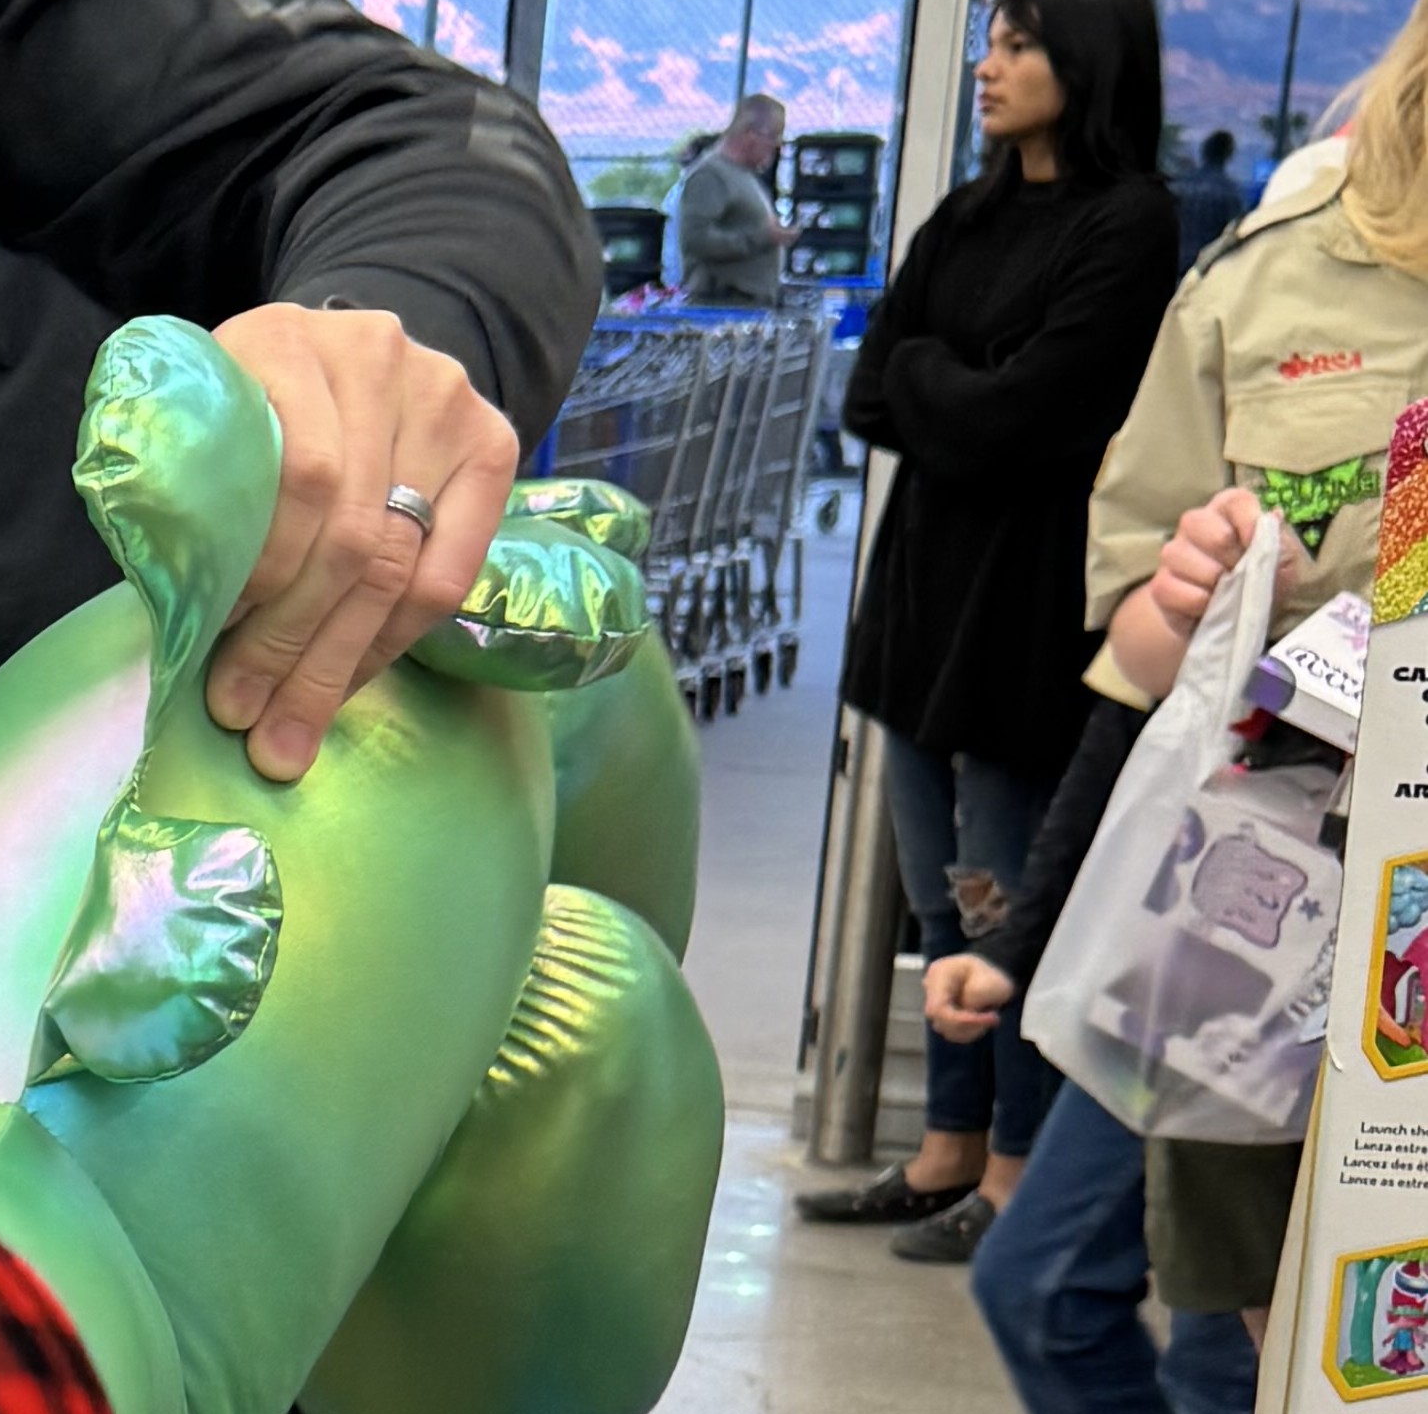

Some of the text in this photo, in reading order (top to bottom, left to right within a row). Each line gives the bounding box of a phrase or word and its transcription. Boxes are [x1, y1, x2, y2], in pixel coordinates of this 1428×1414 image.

[1361, 1121, 1407, 1135] Launch
[1354, 1138, 1392, 1152] Lanza
[1391, 1159, 1413, 1171] des
[1340, 1171, 1377, 1186] Lance
[1380, 1177, 1394, 1187] as
